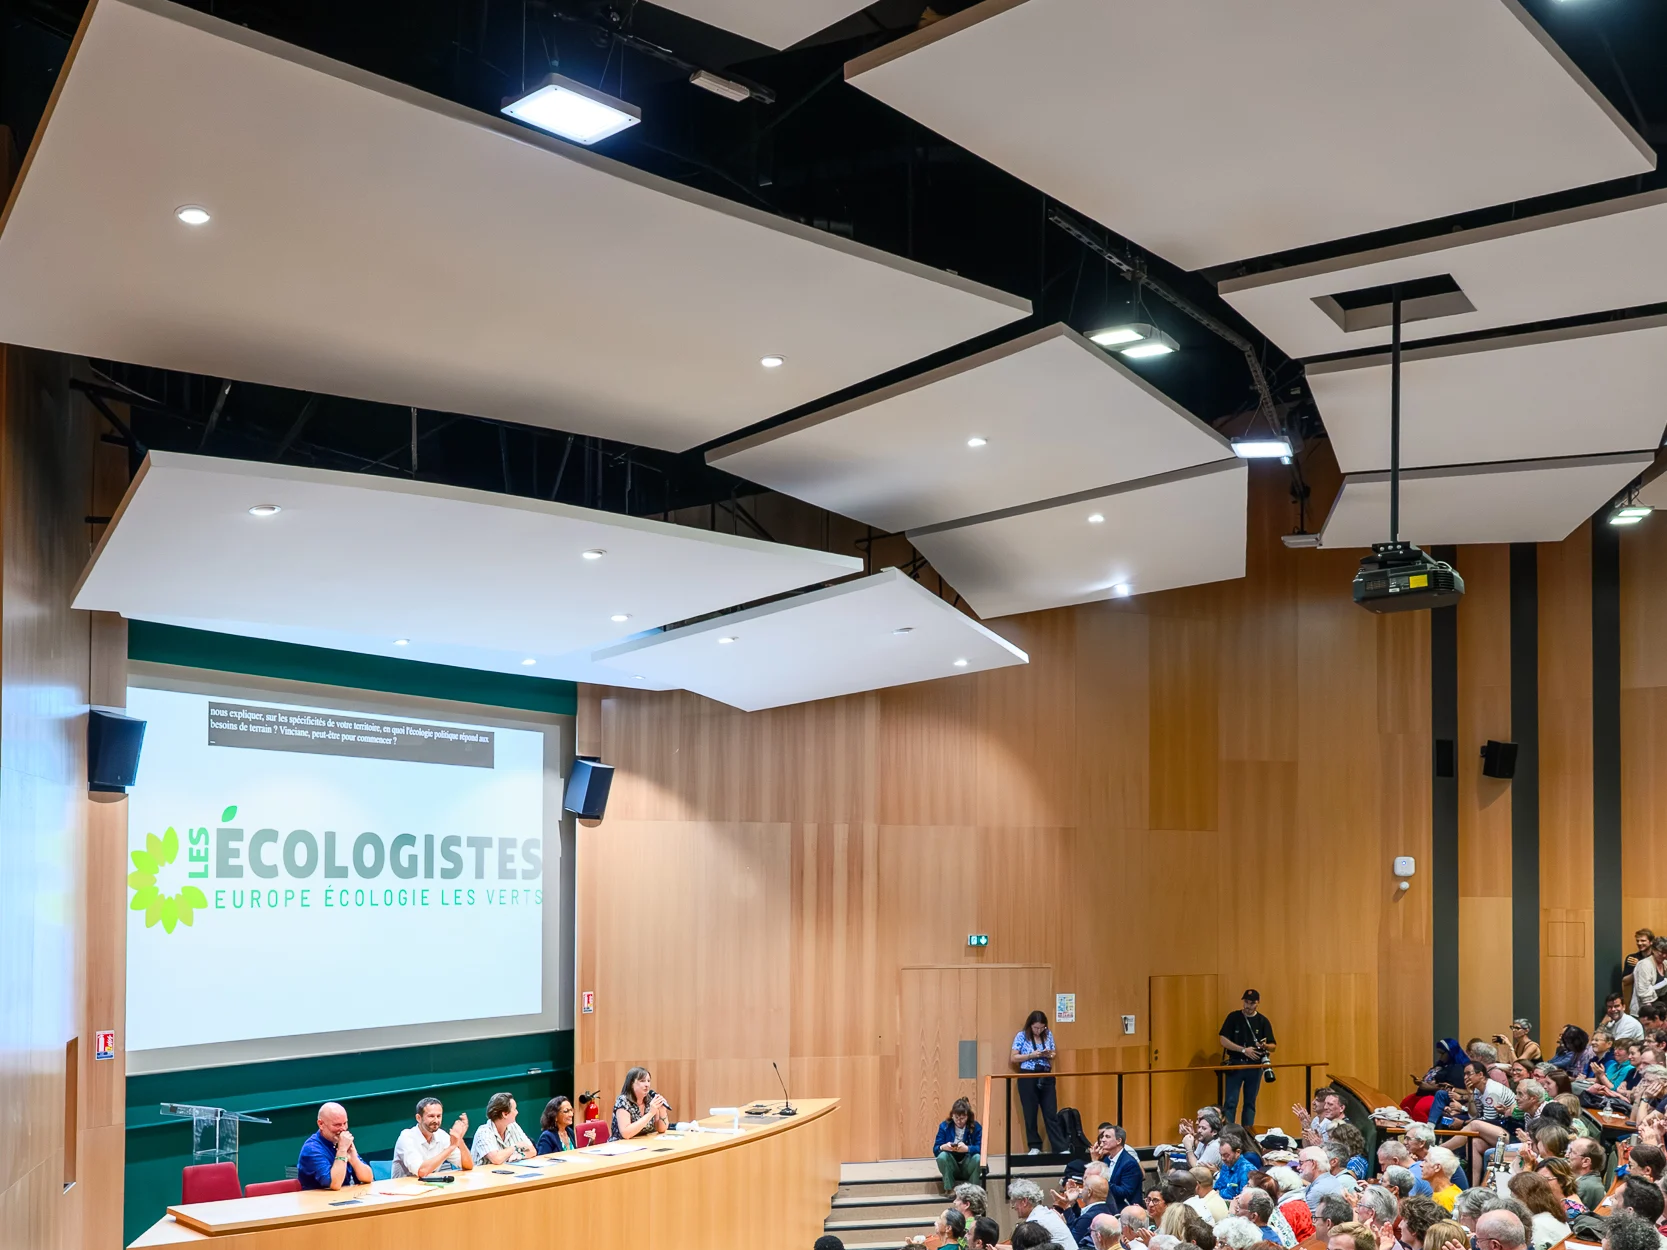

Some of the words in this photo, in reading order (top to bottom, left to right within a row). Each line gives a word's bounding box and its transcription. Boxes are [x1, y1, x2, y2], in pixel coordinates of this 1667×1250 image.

[210, 708, 228, 717] nous
[229, 709, 264, 721] expliquer,
[266, 713, 277, 722] sur
[278, 713, 288, 722] les
[289, 714, 326, 727] spécificités
[327, 718, 335, 728] de
[336, 720, 352, 729] votre
[354, 722, 382, 734] territoire,
[383, 726, 391, 734] en
[392, 726, 405, 736] quoi
[434, 730, 458, 742] politique
[459, 732, 478, 743] répond
[210, 719, 238, 731] besoins
[239, 722, 248, 731] de
[249, 724, 272, 734] terrain
[273, 725, 277, 734] ?
[280, 725, 310, 738] Vinciane,
[311, 730, 340, 740] peut-être
[342, 733, 356, 742] pour
[356, 736, 392, 745] commencer
[393, 736, 398, 745] ?
[188, 826, 210, 879] LES
[215, 805, 543, 880] ÉCOLOGISTES
[215, 889, 311, 909] EUROPE
[324, 884, 430, 907] ÉCOLOGIE
[441, 889, 476, 906] LES
[486, 889, 543, 905] VERTS
